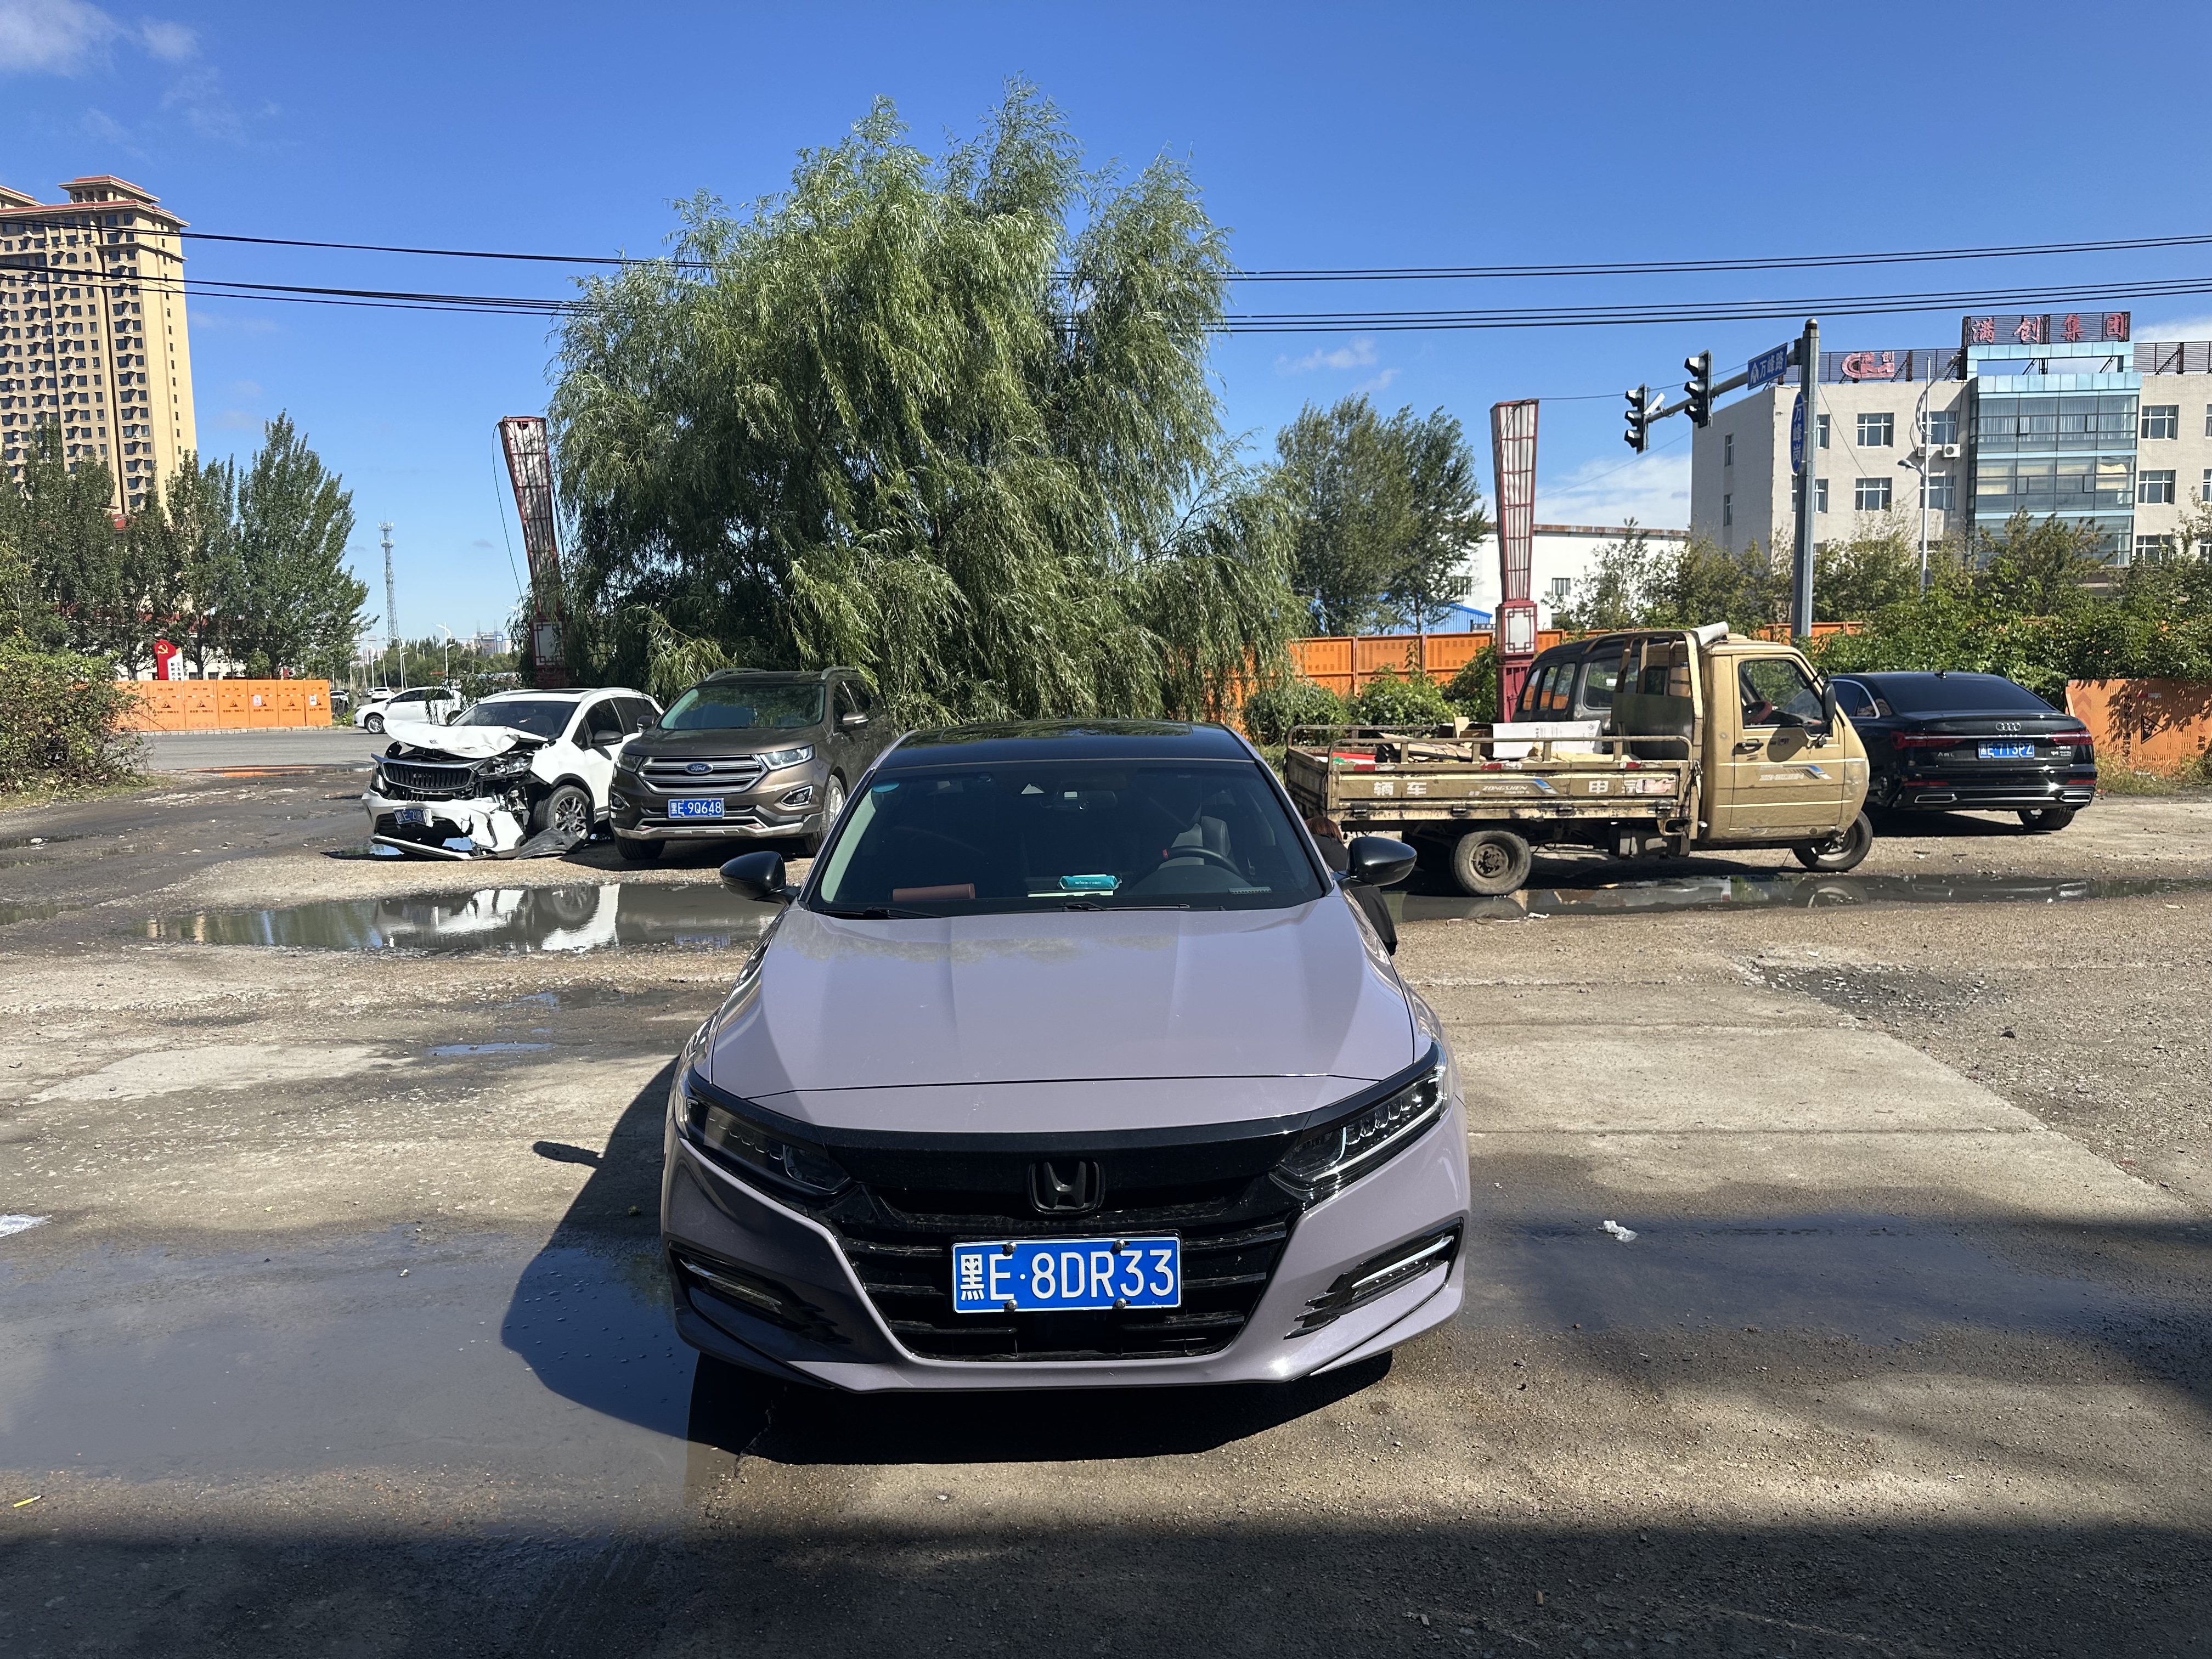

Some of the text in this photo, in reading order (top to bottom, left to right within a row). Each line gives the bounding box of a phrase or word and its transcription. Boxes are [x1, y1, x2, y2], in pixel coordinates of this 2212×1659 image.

[1759, 351, 1784, 379] 万峰路
[1792, 403, 1803, 464] 万峰岗
